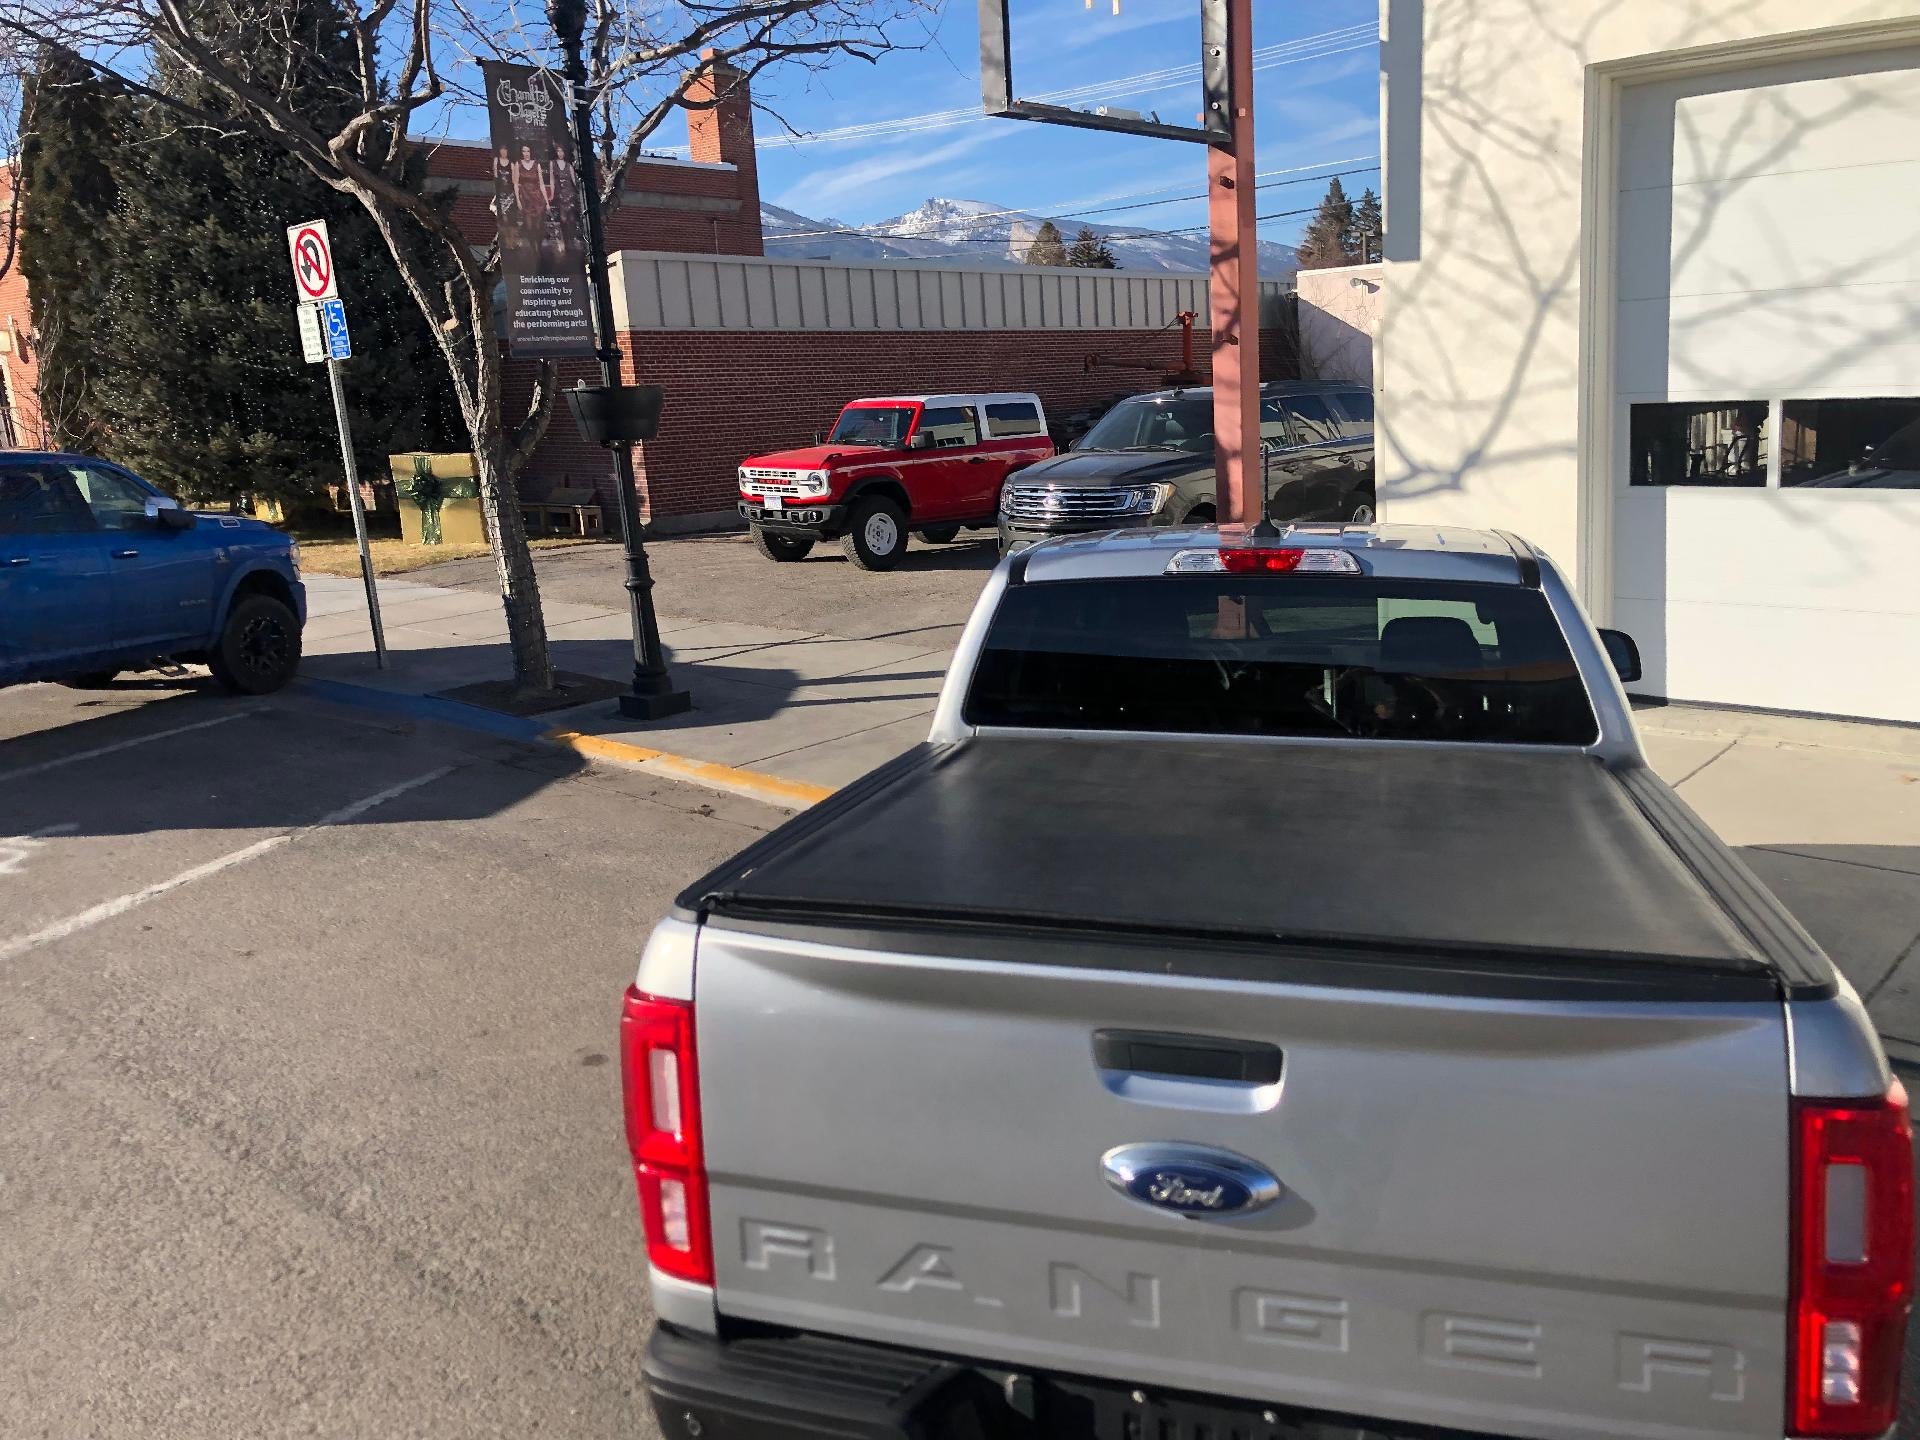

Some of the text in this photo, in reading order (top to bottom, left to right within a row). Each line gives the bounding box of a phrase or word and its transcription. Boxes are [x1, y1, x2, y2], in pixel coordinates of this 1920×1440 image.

[520, 276, 555, 284] Enriching
[520, 287, 573, 296] community by
[515, 308, 584, 318] educating through
[513, 319, 526, 328] the
[526, 320, 570, 329] performing
[1150, 1173, 1224, 1208] Ford
[740, 1216, 1745, 1401] RANGER
